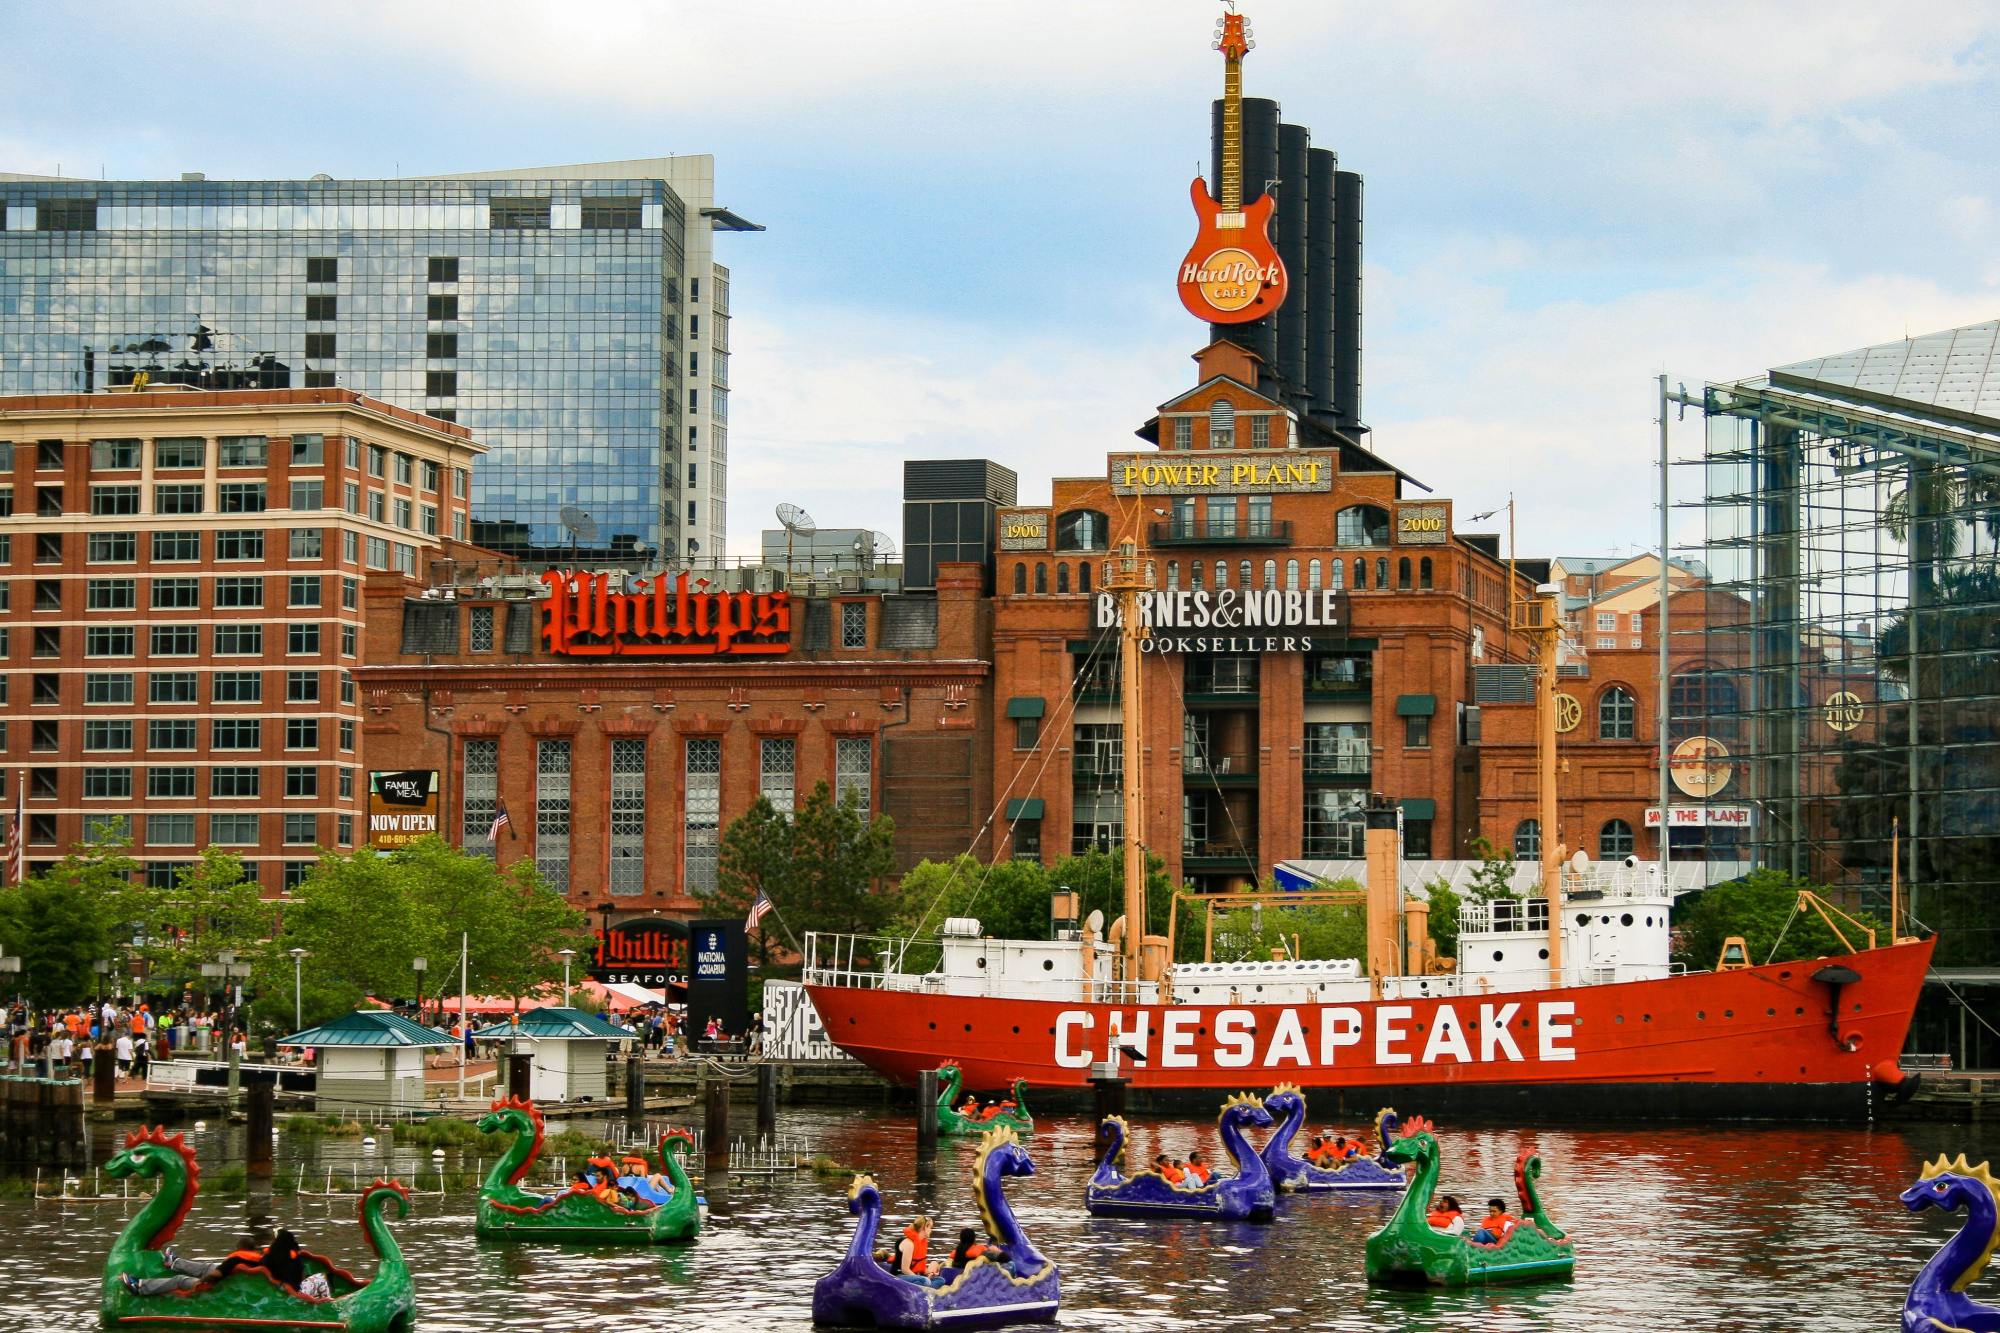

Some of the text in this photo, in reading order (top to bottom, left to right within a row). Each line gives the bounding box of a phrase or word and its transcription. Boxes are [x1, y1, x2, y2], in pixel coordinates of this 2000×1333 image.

[1214, 288, 1247, 298] CAFE
[1124, 462, 1322, 487] POWER PLANT
[1007, 524, 1040, 538] 1900
[1403, 518, 1441, 531] 2000
[541, 569, 790, 654] Phillips
[1140, 637, 1312, 652] OOKSELLERS
[385, 781, 417, 790] FAMILY
[370, 814, 436, 830] NOW OPEN
[1648, 809, 1749, 822] SAV THE PLANET
[763, 986, 811, 1008] HISTO
[763, 1007, 831, 1042] SHIP
[1054, 1001, 1576, 1068] CHESAPEAKE
